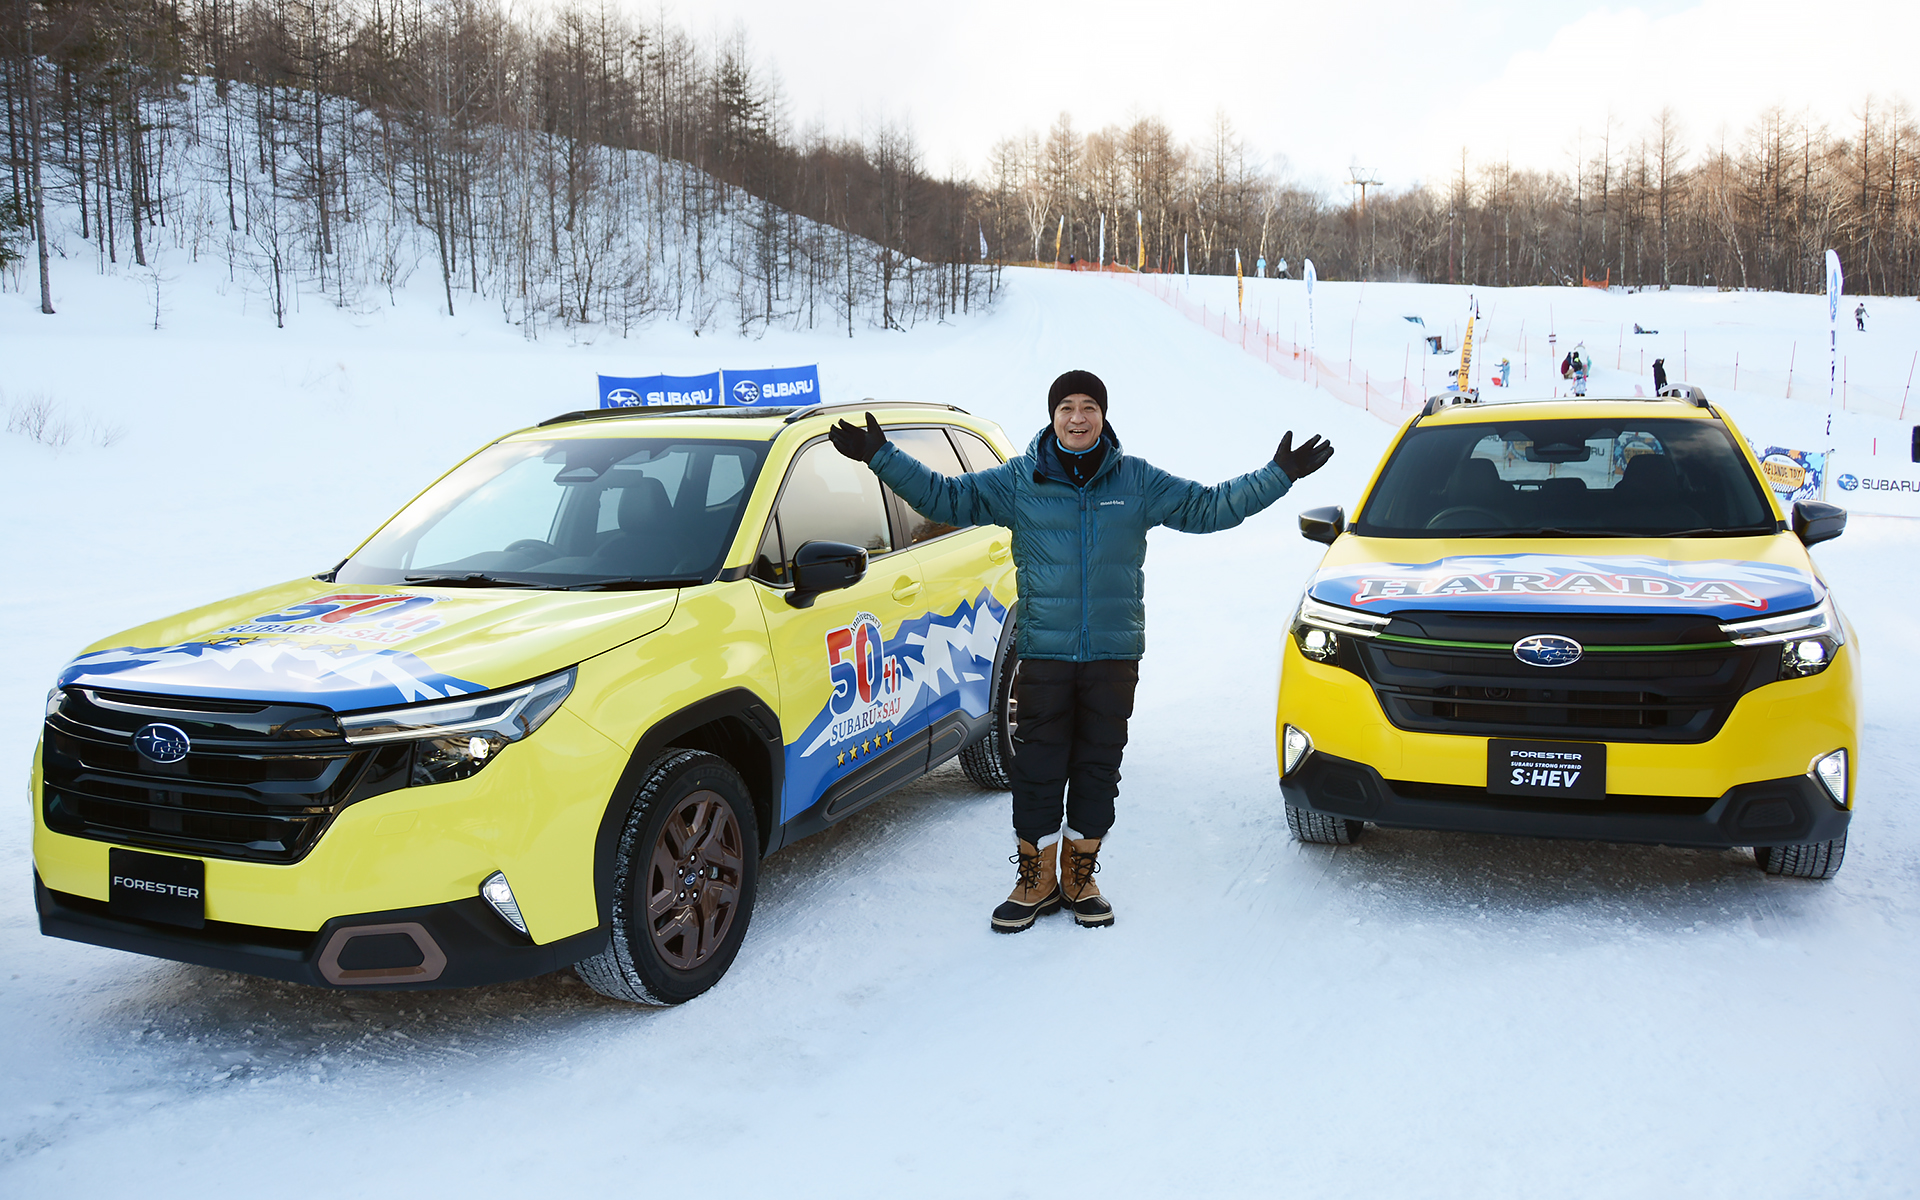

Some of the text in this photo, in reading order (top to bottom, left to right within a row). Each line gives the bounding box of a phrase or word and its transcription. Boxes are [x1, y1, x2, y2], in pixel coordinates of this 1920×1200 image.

[646, 388, 712, 407] SUBARU
[762, 379, 813, 398] SUBARU
[1861, 478, 1920, 493] SUBARU
[1354, 574, 1763, 607] HARADA
[827, 622, 901, 716] 50th
[1510, 750, 1582, 760] FORESTER
[1510, 768, 1580, 788] S:HEV
[113, 876, 200, 899] FORESTER
